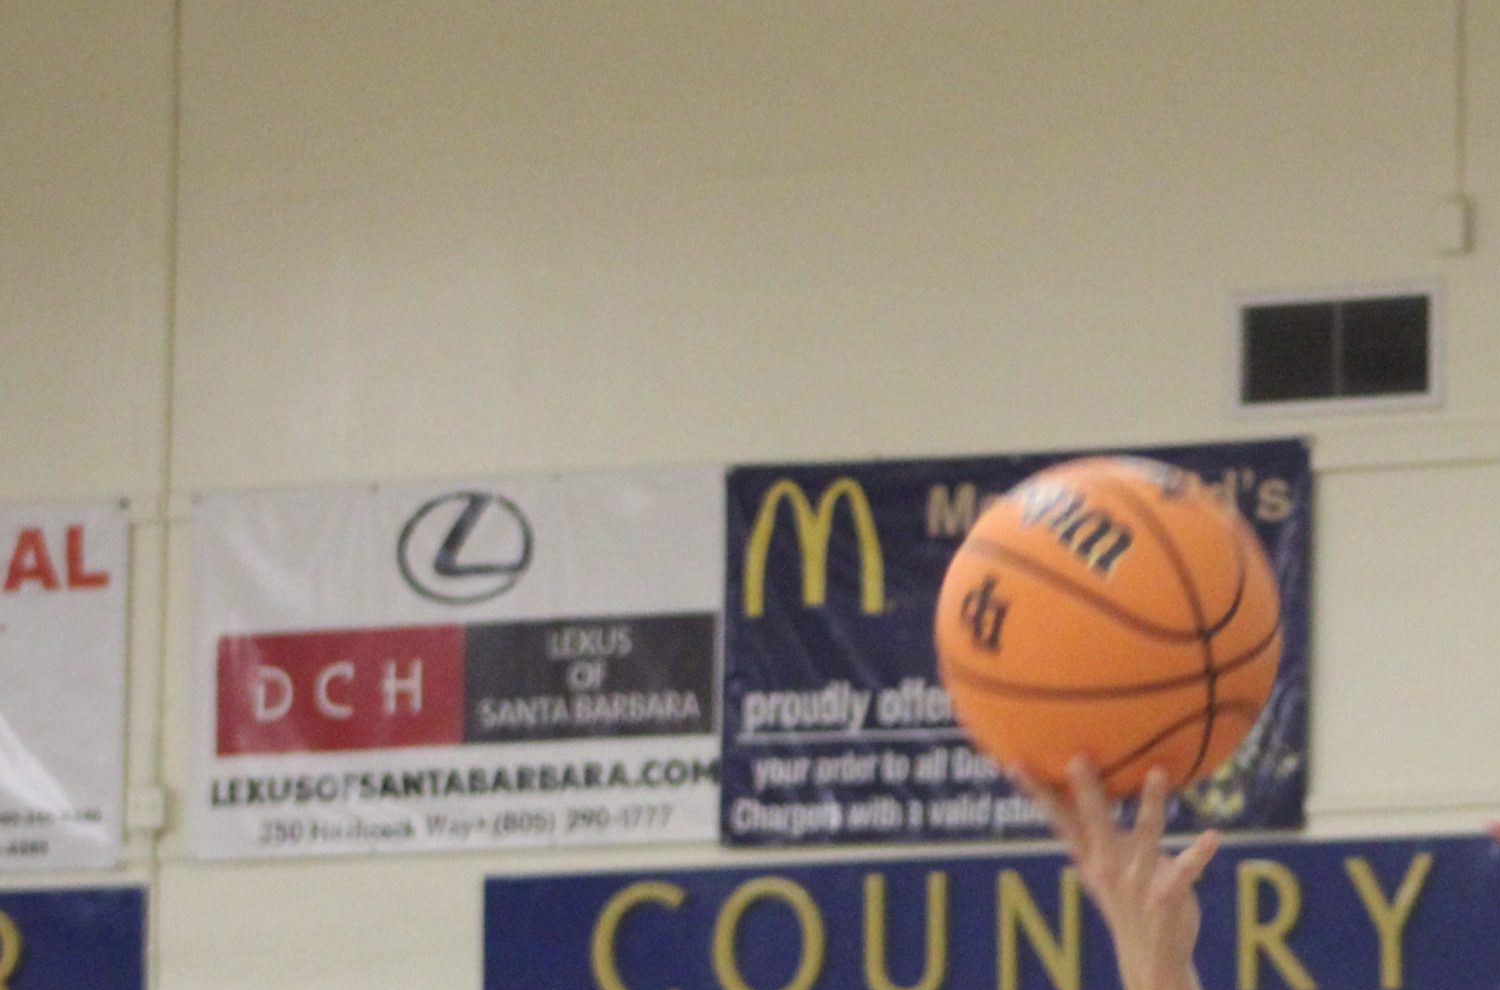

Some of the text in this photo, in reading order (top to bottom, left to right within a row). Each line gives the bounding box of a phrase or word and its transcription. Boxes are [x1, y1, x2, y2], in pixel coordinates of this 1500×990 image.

[548, 627, 634, 661] LEXUS
[566, 659, 609, 692] OF
[477, 689, 701, 732] SANTA BARBARA
[740, 680, 872, 735] proudly
[210, 759, 720, 806] LEXUSOFSANTABARBARA.COM
[754, 757, 811, 791] your
[813, 751, 878, 785] order
[880, 750, 911, 784] to
[914, 747, 950, 783] all
[730, 798, 843, 836] Chargers
[847, 796, 901, 829] with
[908, 801, 926, 830] a
[928, 795, 992, 829] valid
